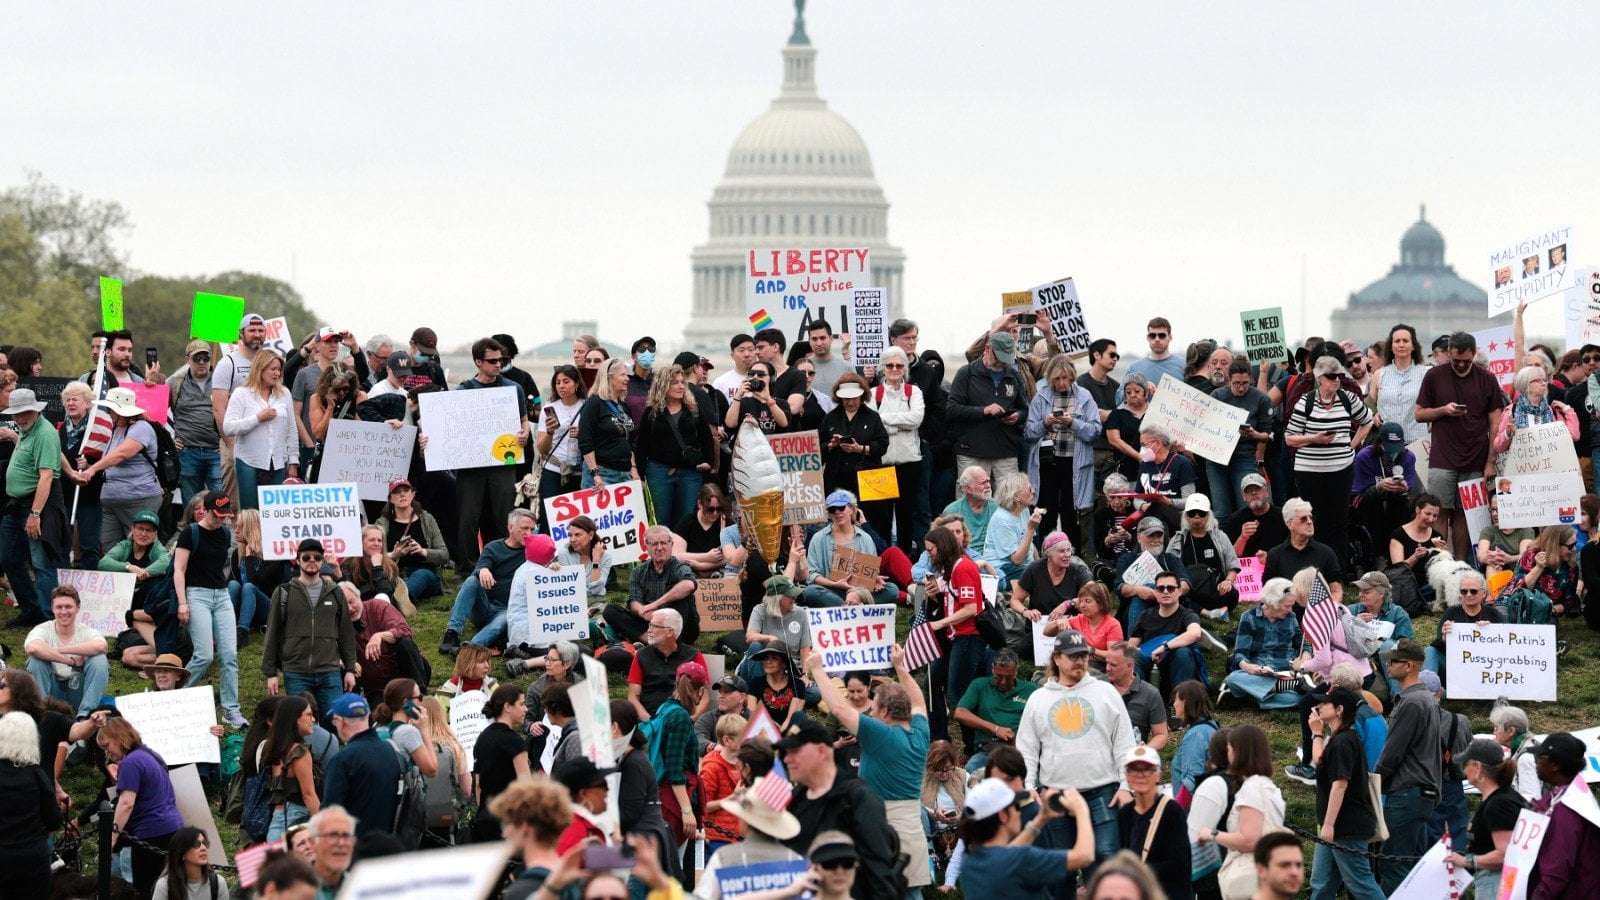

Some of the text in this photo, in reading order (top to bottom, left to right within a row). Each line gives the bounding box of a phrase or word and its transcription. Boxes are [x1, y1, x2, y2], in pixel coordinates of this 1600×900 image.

[1490, 229, 1570, 266] MALIGNANT
[749, 249, 868, 277] LIBERTY
[801, 277, 854, 292] Justice
[1494, 266, 1566, 309] STUPIDITY
[784, 296, 807, 310] FOR
[855, 298, 881, 307] OFF!
[1038, 284, 1066, 306] STOP
[857, 324, 882, 333] OFF!
[1067, 315, 1086, 333] ON
[1244, 316, 1280, 332] WE NEED
[1058, 332, 1090, 353] ENCE
[1245, 331, 1281, 347] FEDERAL
[1246, 345, 1284, 361] WORKERS
[336, 431, 356, 440] WHEN
[769, 436, 818, 455] VERYONE
[778, 454, 821, 472] ERVES
[263, 487, 353, 505] DIVERSITY
[552, 486, 632, 521] STOP
[263, 505, 356, 519] IS OUR STRENGTH
[281, 524, 333, 538] STAND
[272, 538, 346, 556] UNED
[534, 575, 549, 585] So
[699, 580, 724, 592] Stop
[537, 604, 580, 616] So little
[711, 612, 741, 621] democr
[810, 608, 895, 625] IS THIS WHAT
[818, 624, 886, 649] GREAT
[1509, 632, 1545, 646] Putin's
[822, 645, 893, 668] OOKS LIKE
[1462, 650, 1548, 672] Pussy-grabbing
[1481, 671, 1526, 684] PuPPet
